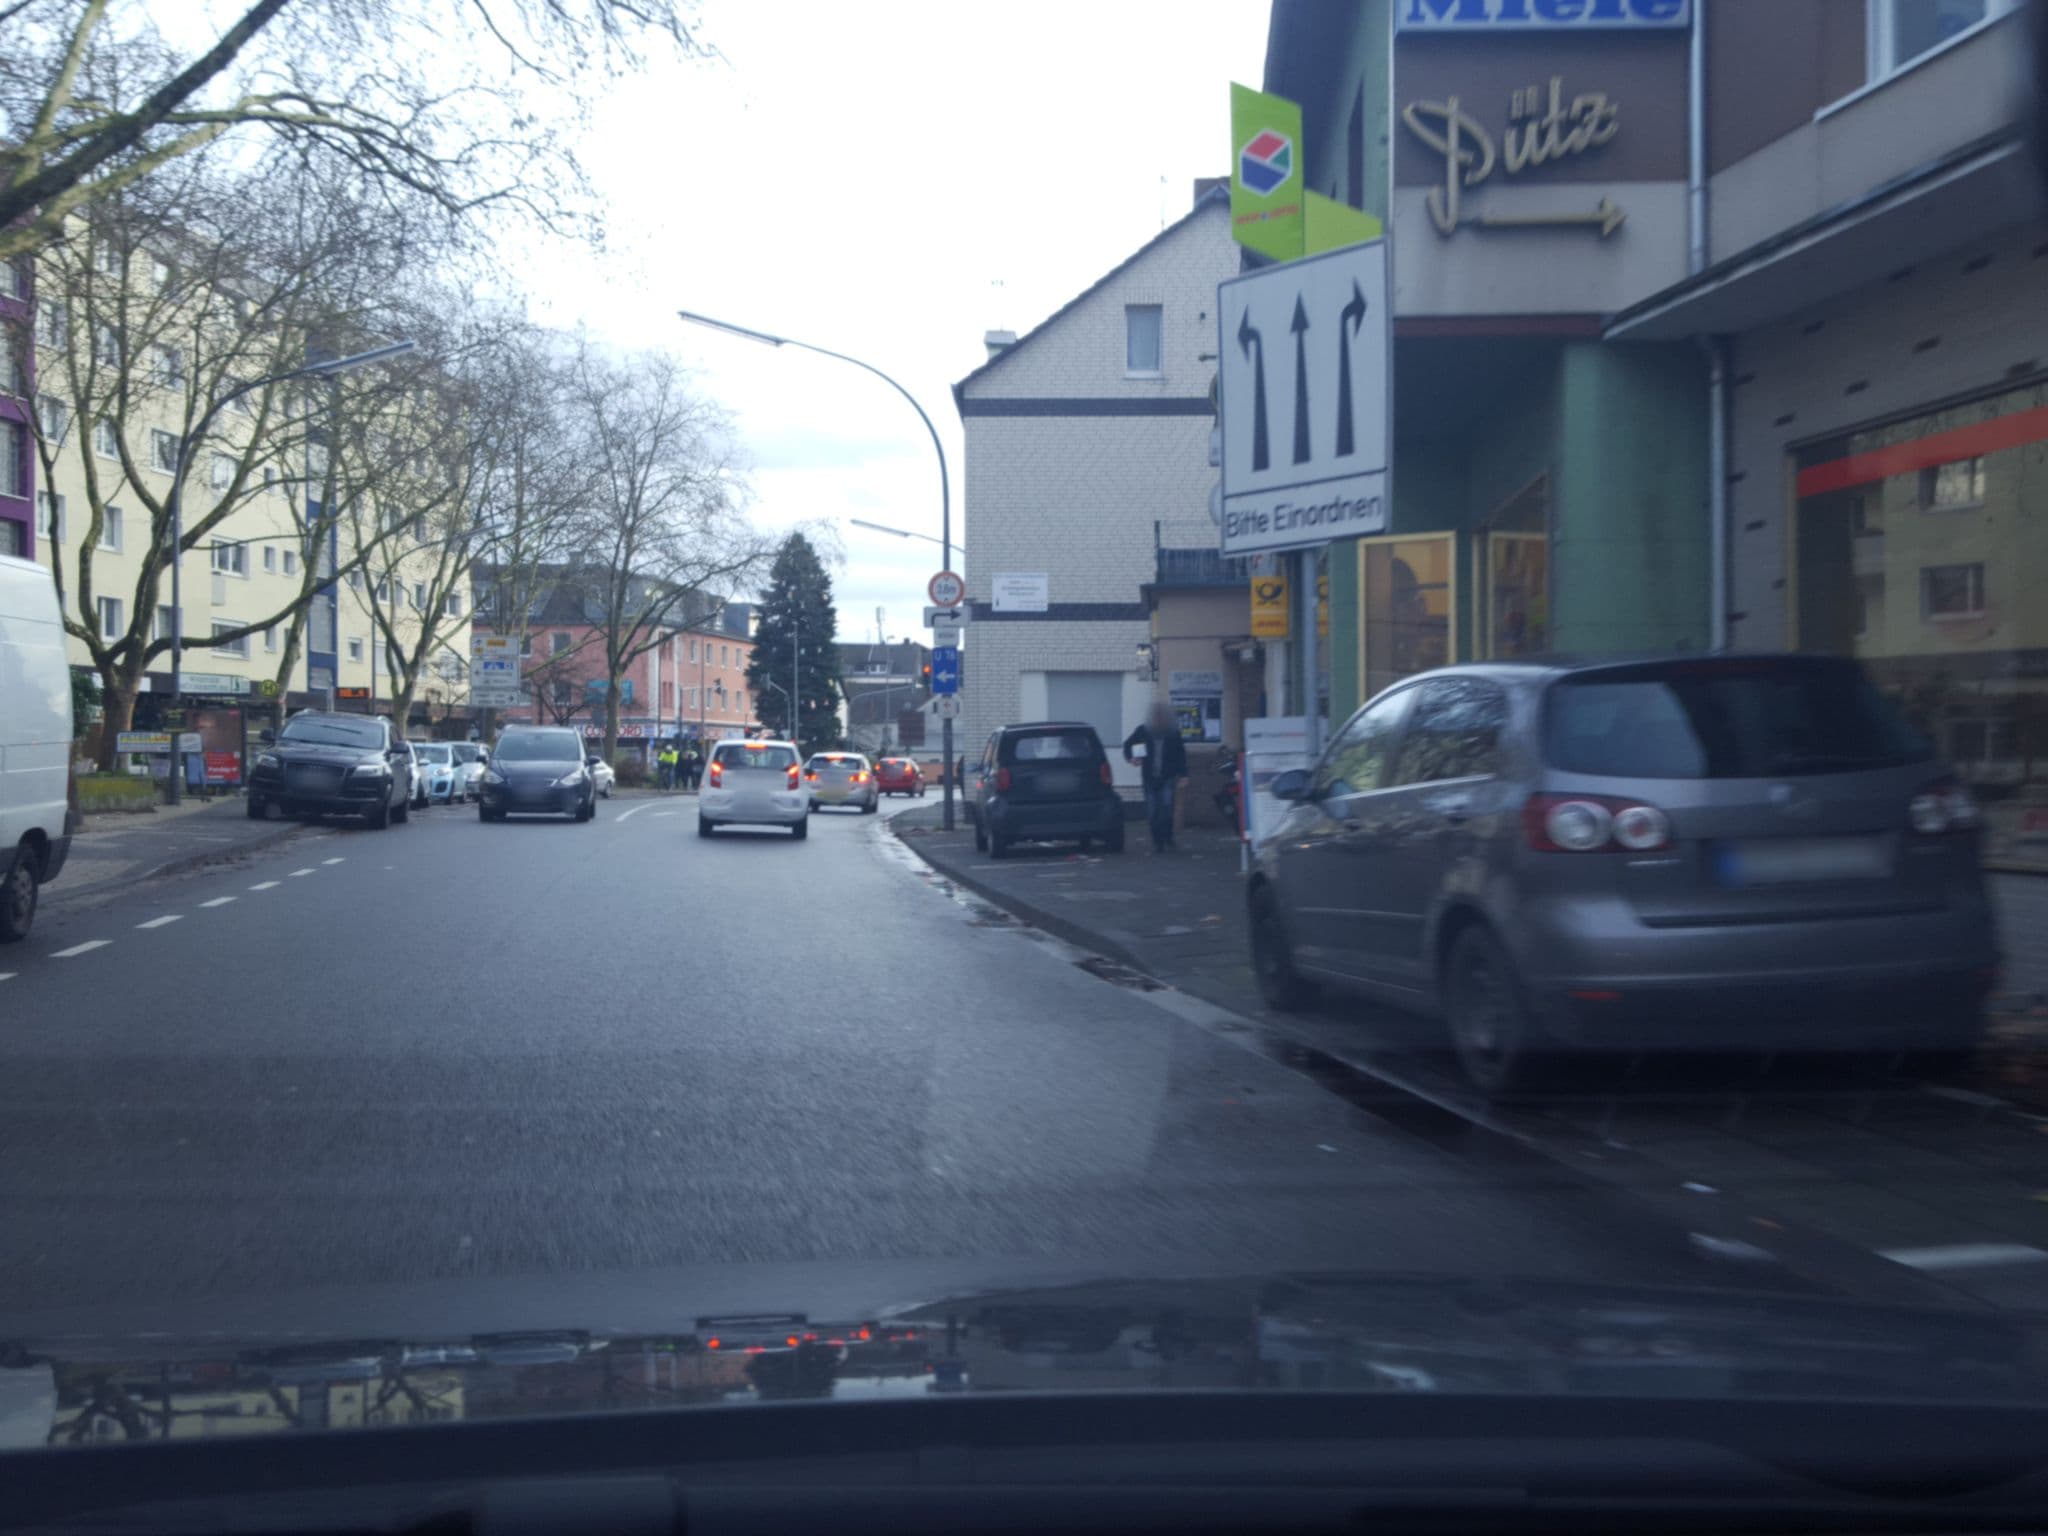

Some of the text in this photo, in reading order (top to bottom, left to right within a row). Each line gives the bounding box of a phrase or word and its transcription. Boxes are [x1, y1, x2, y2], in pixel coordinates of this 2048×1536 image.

[1402, 74, 1620, 234] Pütz
[1226, 496, 1382, 539] Bitte Einordnen
